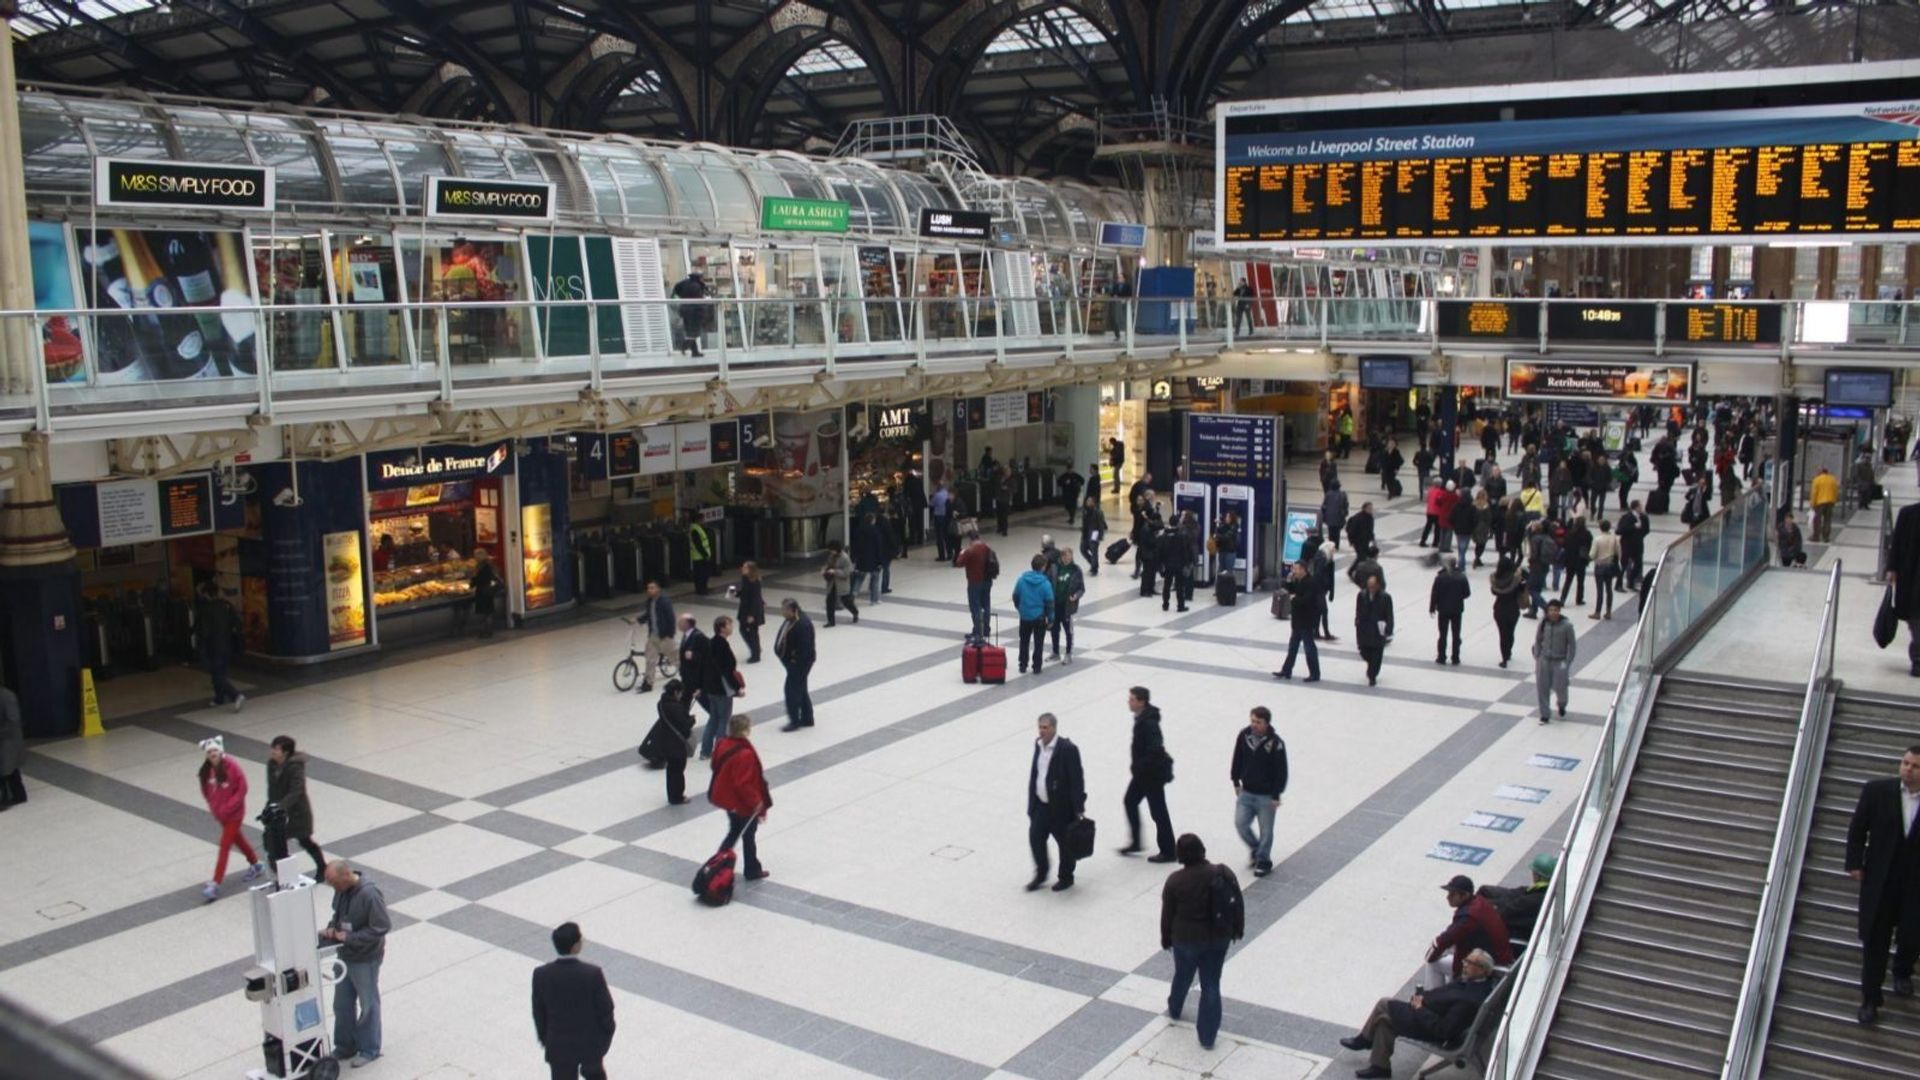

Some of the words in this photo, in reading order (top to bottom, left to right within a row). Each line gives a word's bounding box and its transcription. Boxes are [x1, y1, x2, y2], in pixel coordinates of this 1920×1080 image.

[1247, 145, 1294, 157] Welcome
[1296, 145, 1308, 155] to
[1310, 138, 1373, 156] Liverpool
[1375, 137, 1417, 152] Street
[1421, 135, 1475, 149] Station
[120, 174, 158, 192] M&S
[159, 176, 211, 195] SIMPLY
[211, 178, 256, 196] FOOD
[445, 190, 471, 206] M&S
[471, 191, 509, 207] SIMPLY
[509, 193, 541, 208] FOOD
[772, 204, 806, 217] LAURA
[807, 206, 844, 218] ASHLEY
[930, 214, 952, 225] LUSH
[1547, 377, 1603, 389] Retribution.
[879, 407, 911, 427] AMT
[956, 402, 965, 419] 6
[743, 424, 753, 444] 5
[879, 425, 910, 438] COFFEE
[590, 439, 603, 461] 4
[426, 458, 443, 473] de
[444, 456, 486, 471] France
